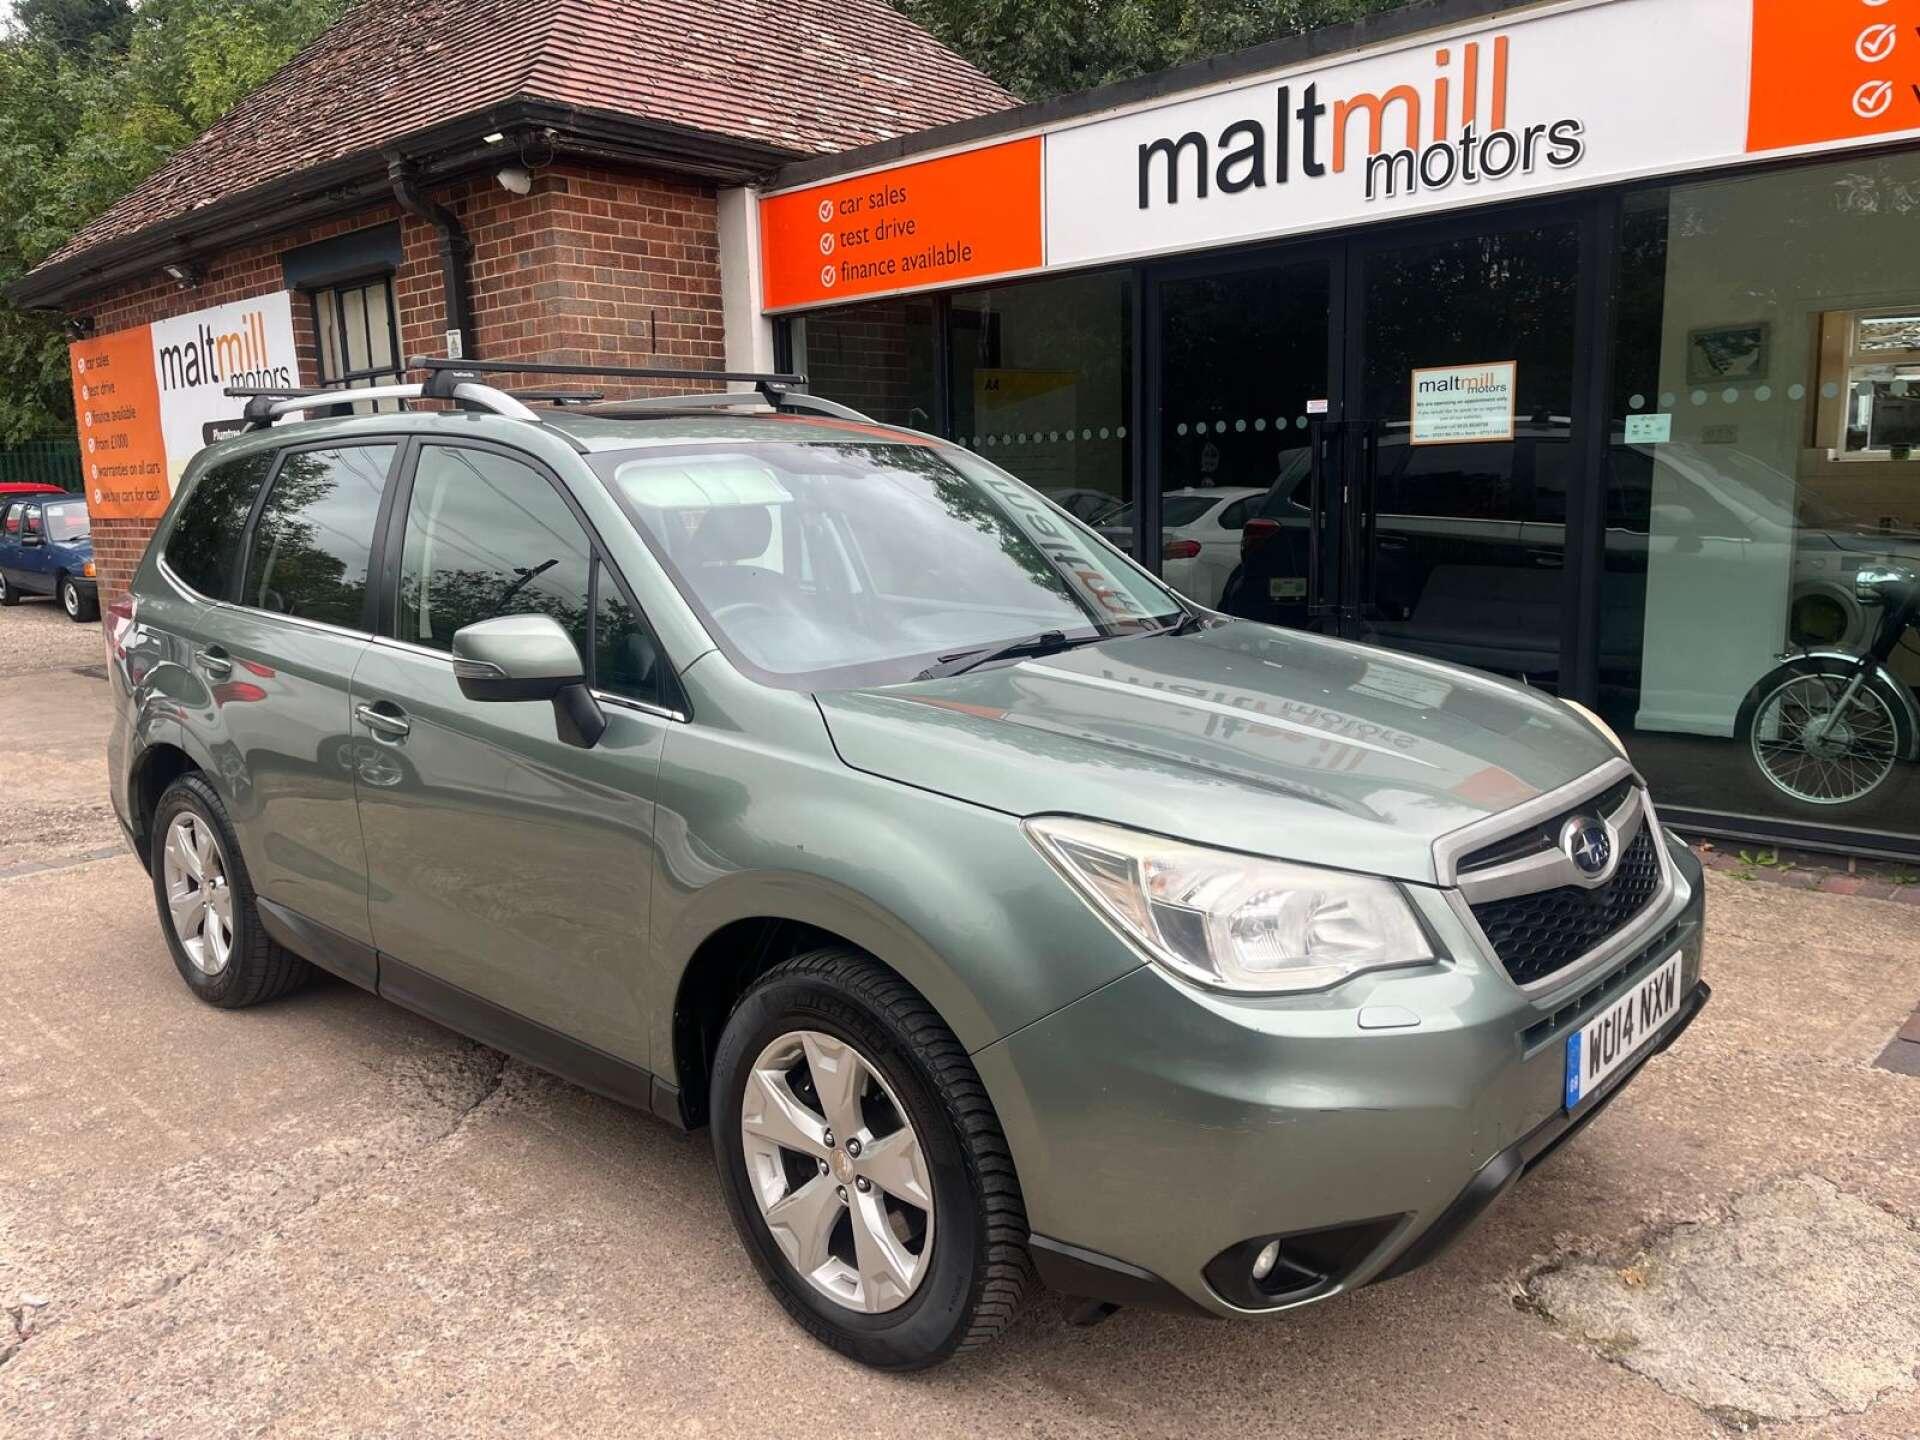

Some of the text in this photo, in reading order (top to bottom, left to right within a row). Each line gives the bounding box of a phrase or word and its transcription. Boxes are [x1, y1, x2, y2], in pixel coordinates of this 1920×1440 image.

[1138, 36, 1508, 210] maltmill
[1364, 117, 1584, 202] motors
[839, 184, 907, 215] car sales
[840, 218, 916, 248] test drive
[841, 241, 972, 282] finance available
[160, 311, 269, 391] maltmill
[230, 364, 291, 390] motors
[1419, 372, 1494, 393] maltmill
[1467, 383, 1507, 394] motors
[1639, 962, 1676, 1035] NXW
